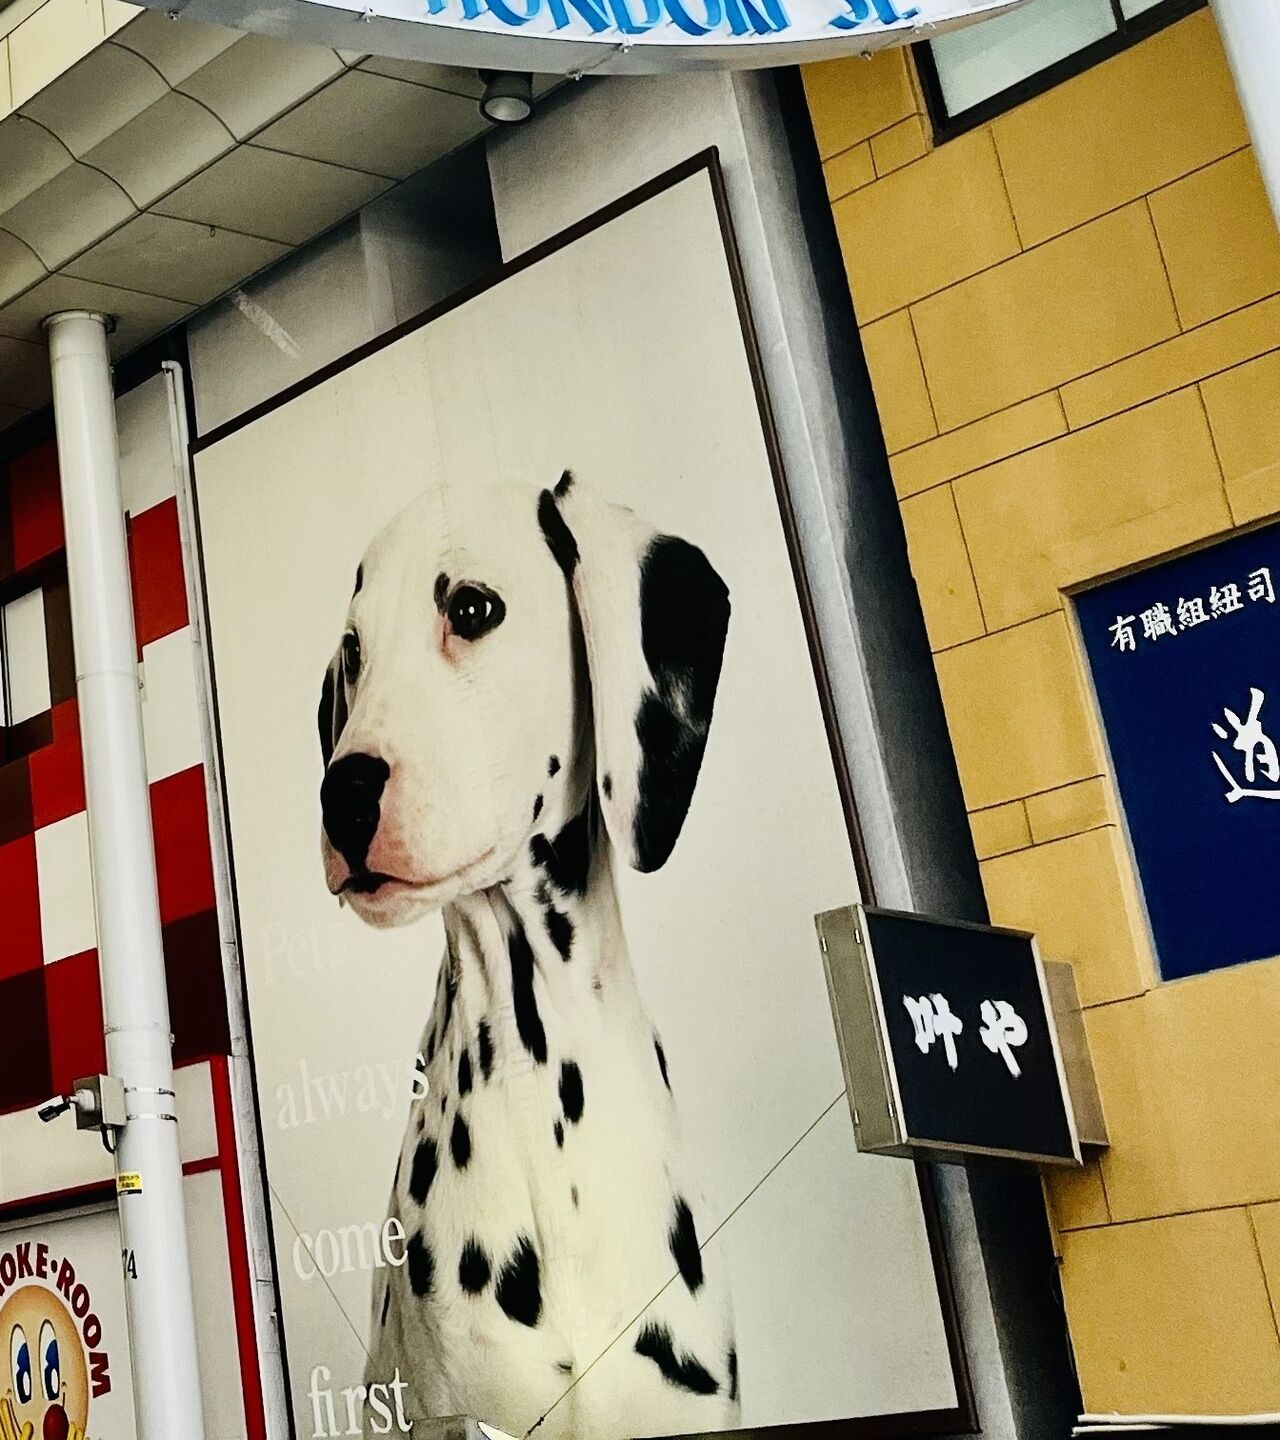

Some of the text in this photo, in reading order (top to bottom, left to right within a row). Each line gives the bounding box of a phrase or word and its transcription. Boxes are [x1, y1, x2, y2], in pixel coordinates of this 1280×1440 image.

[1107, 566, 1276, 653] 有職組紐司
[275, 1050, 430, 1132] always
[293, 1214, 409, 1282] come
[306, 1363, 414, 1439] first
